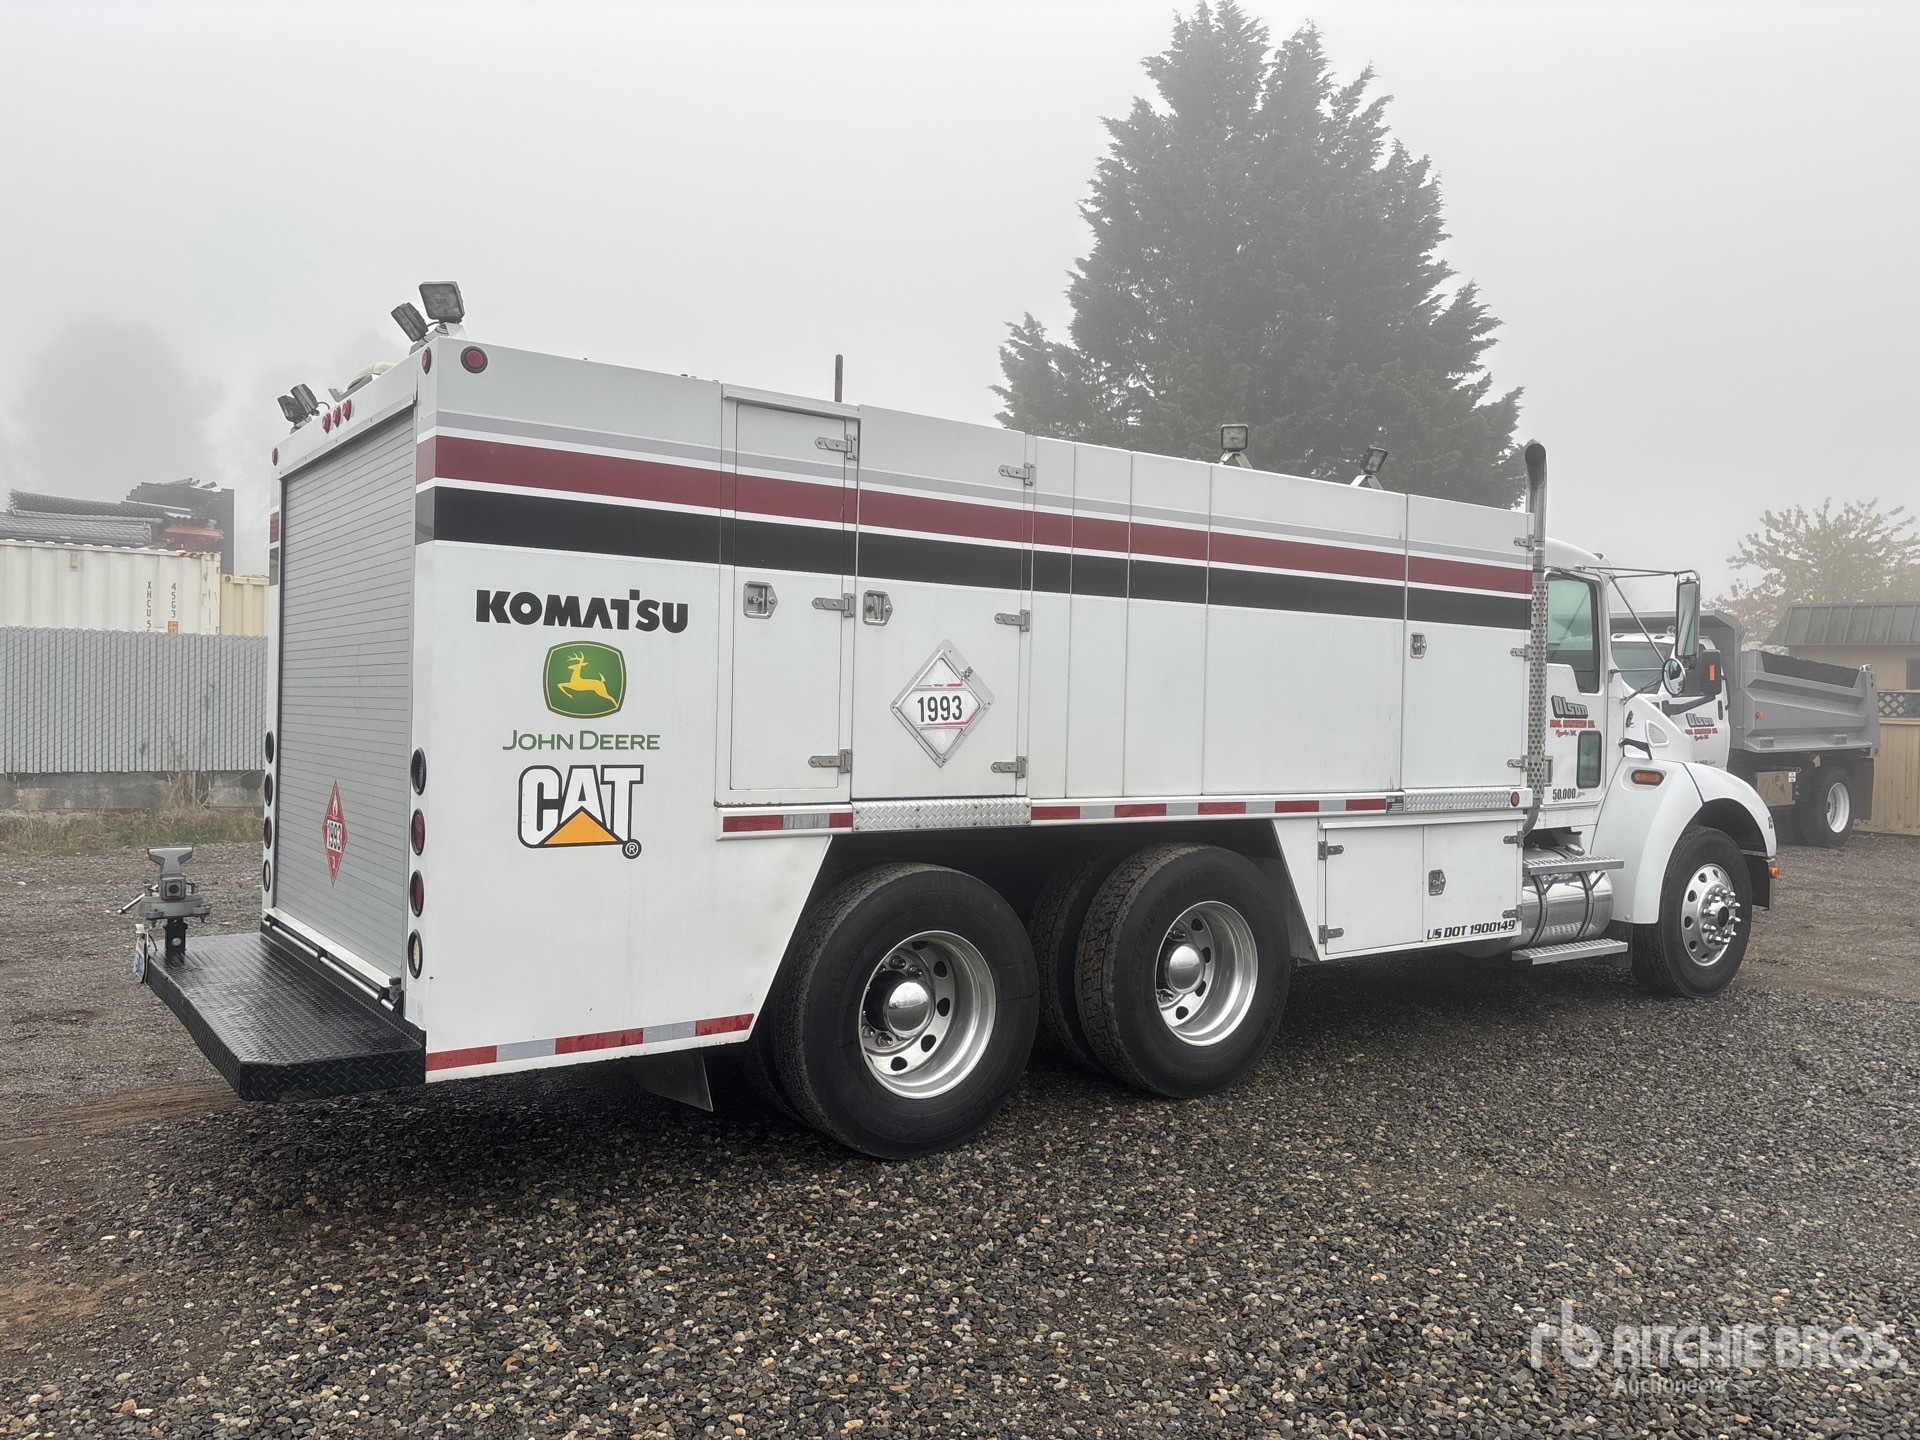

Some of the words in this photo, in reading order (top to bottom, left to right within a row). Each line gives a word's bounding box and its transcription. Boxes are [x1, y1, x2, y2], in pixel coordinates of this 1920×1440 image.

[476, 589, 688, 633] KOMATSU
[917, 695, 962, 722] 1993
[502, 729, 573, 751] JOHN
[579, 730, 660, 751] DEERE
[518, 764, 644, 849] CAT
[327, 821, 342, 851] 1993
[1427, 928, 1442, 940] US
[1444, 925, 1468, 938] DOT
[1470, 919, 1515, 934] 1900149
